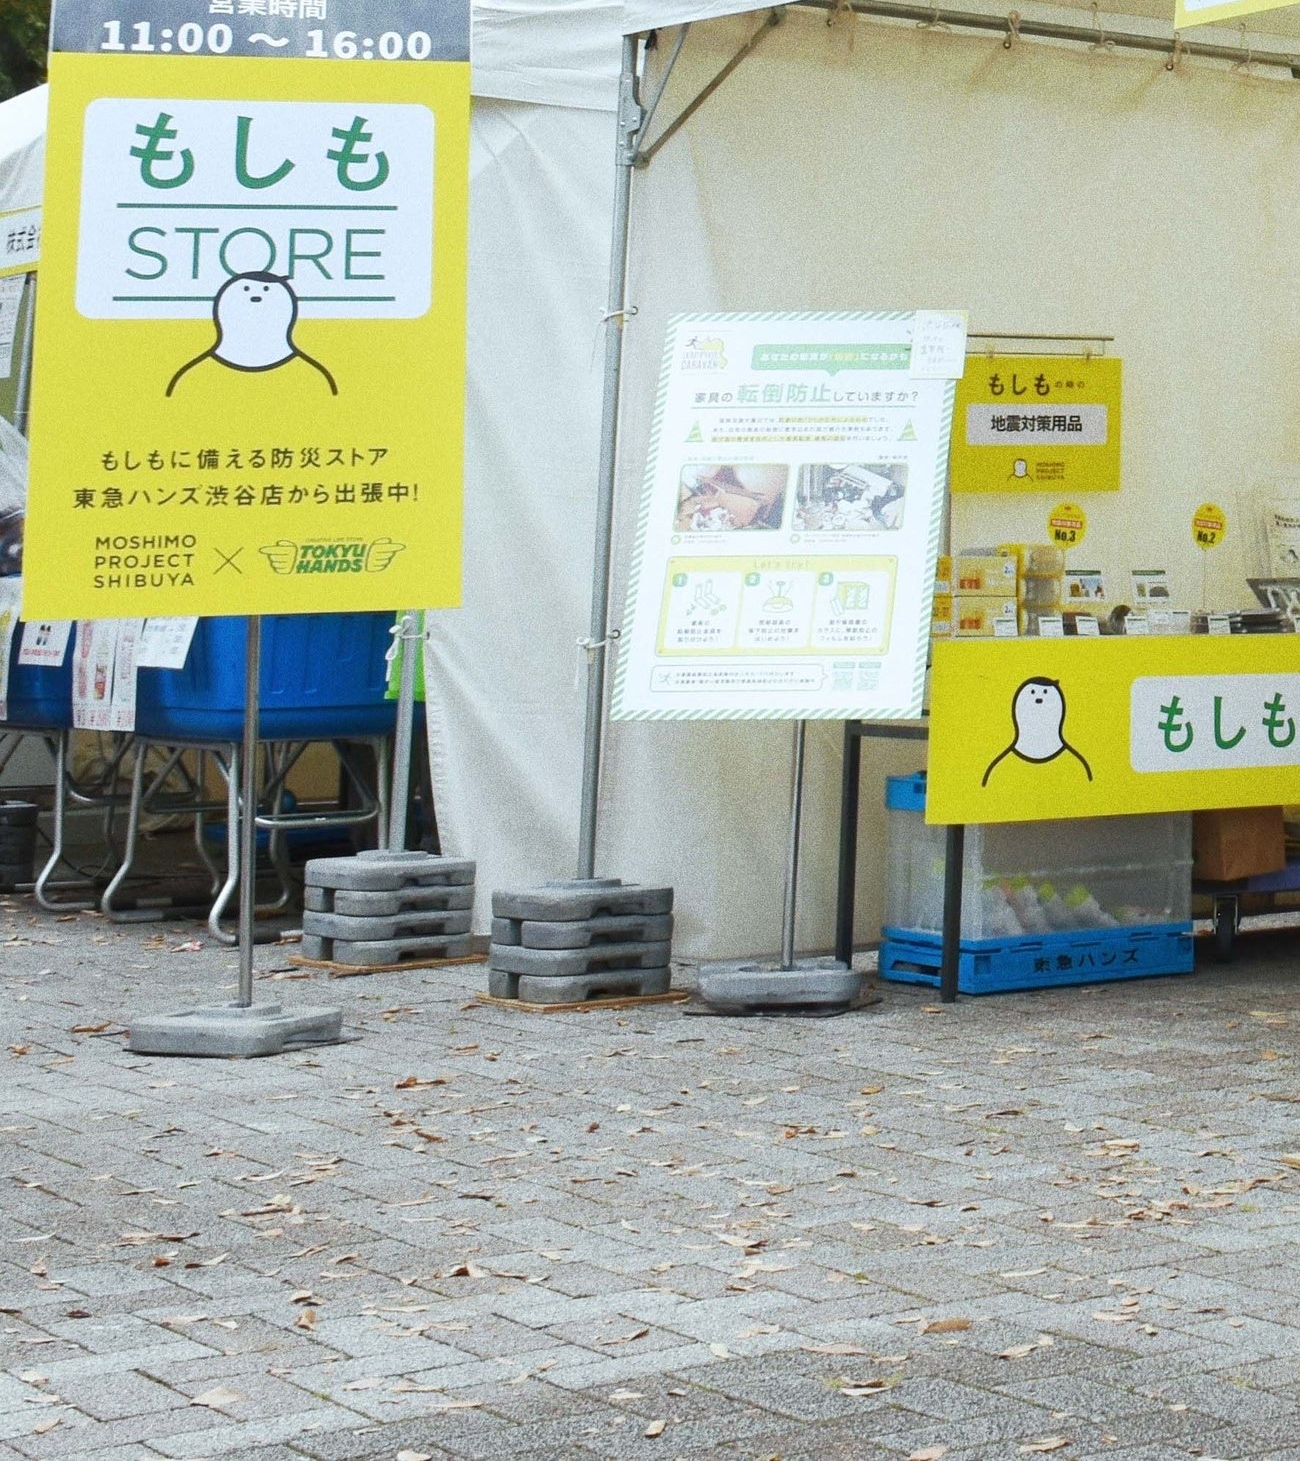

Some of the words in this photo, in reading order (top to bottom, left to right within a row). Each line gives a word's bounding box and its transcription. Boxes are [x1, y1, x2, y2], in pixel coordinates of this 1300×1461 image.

[100, 19, 233, 55] 11:00
[304, 29, 434, 62] 16:00
[128, 111, 393, 191] もしも
[7, 224, 41, 255] 株式会
[124, 226, 388, 282] STORE
[990, 414, 1082, 432] 地震対策用品
[99, 445, 390, 473] もしもに備える防災ストア
[72, 481, 421, 511] 東急ハンズ渋谷店から出張中!
[95, 534, 197, 551] MOSHIMO
[1055, 529, 1076, 543] No.3
[94, 553, 195, 570] PROJECT
[300, 543, 368, 559] TOKYU
[295, 557, 363, 574] HANDS
[93, 572, 195, 590] SHIBUYA
[1156, 691, 1297, 754] もしも
[1032, 947, 1142, 974] 東急ハンズ
